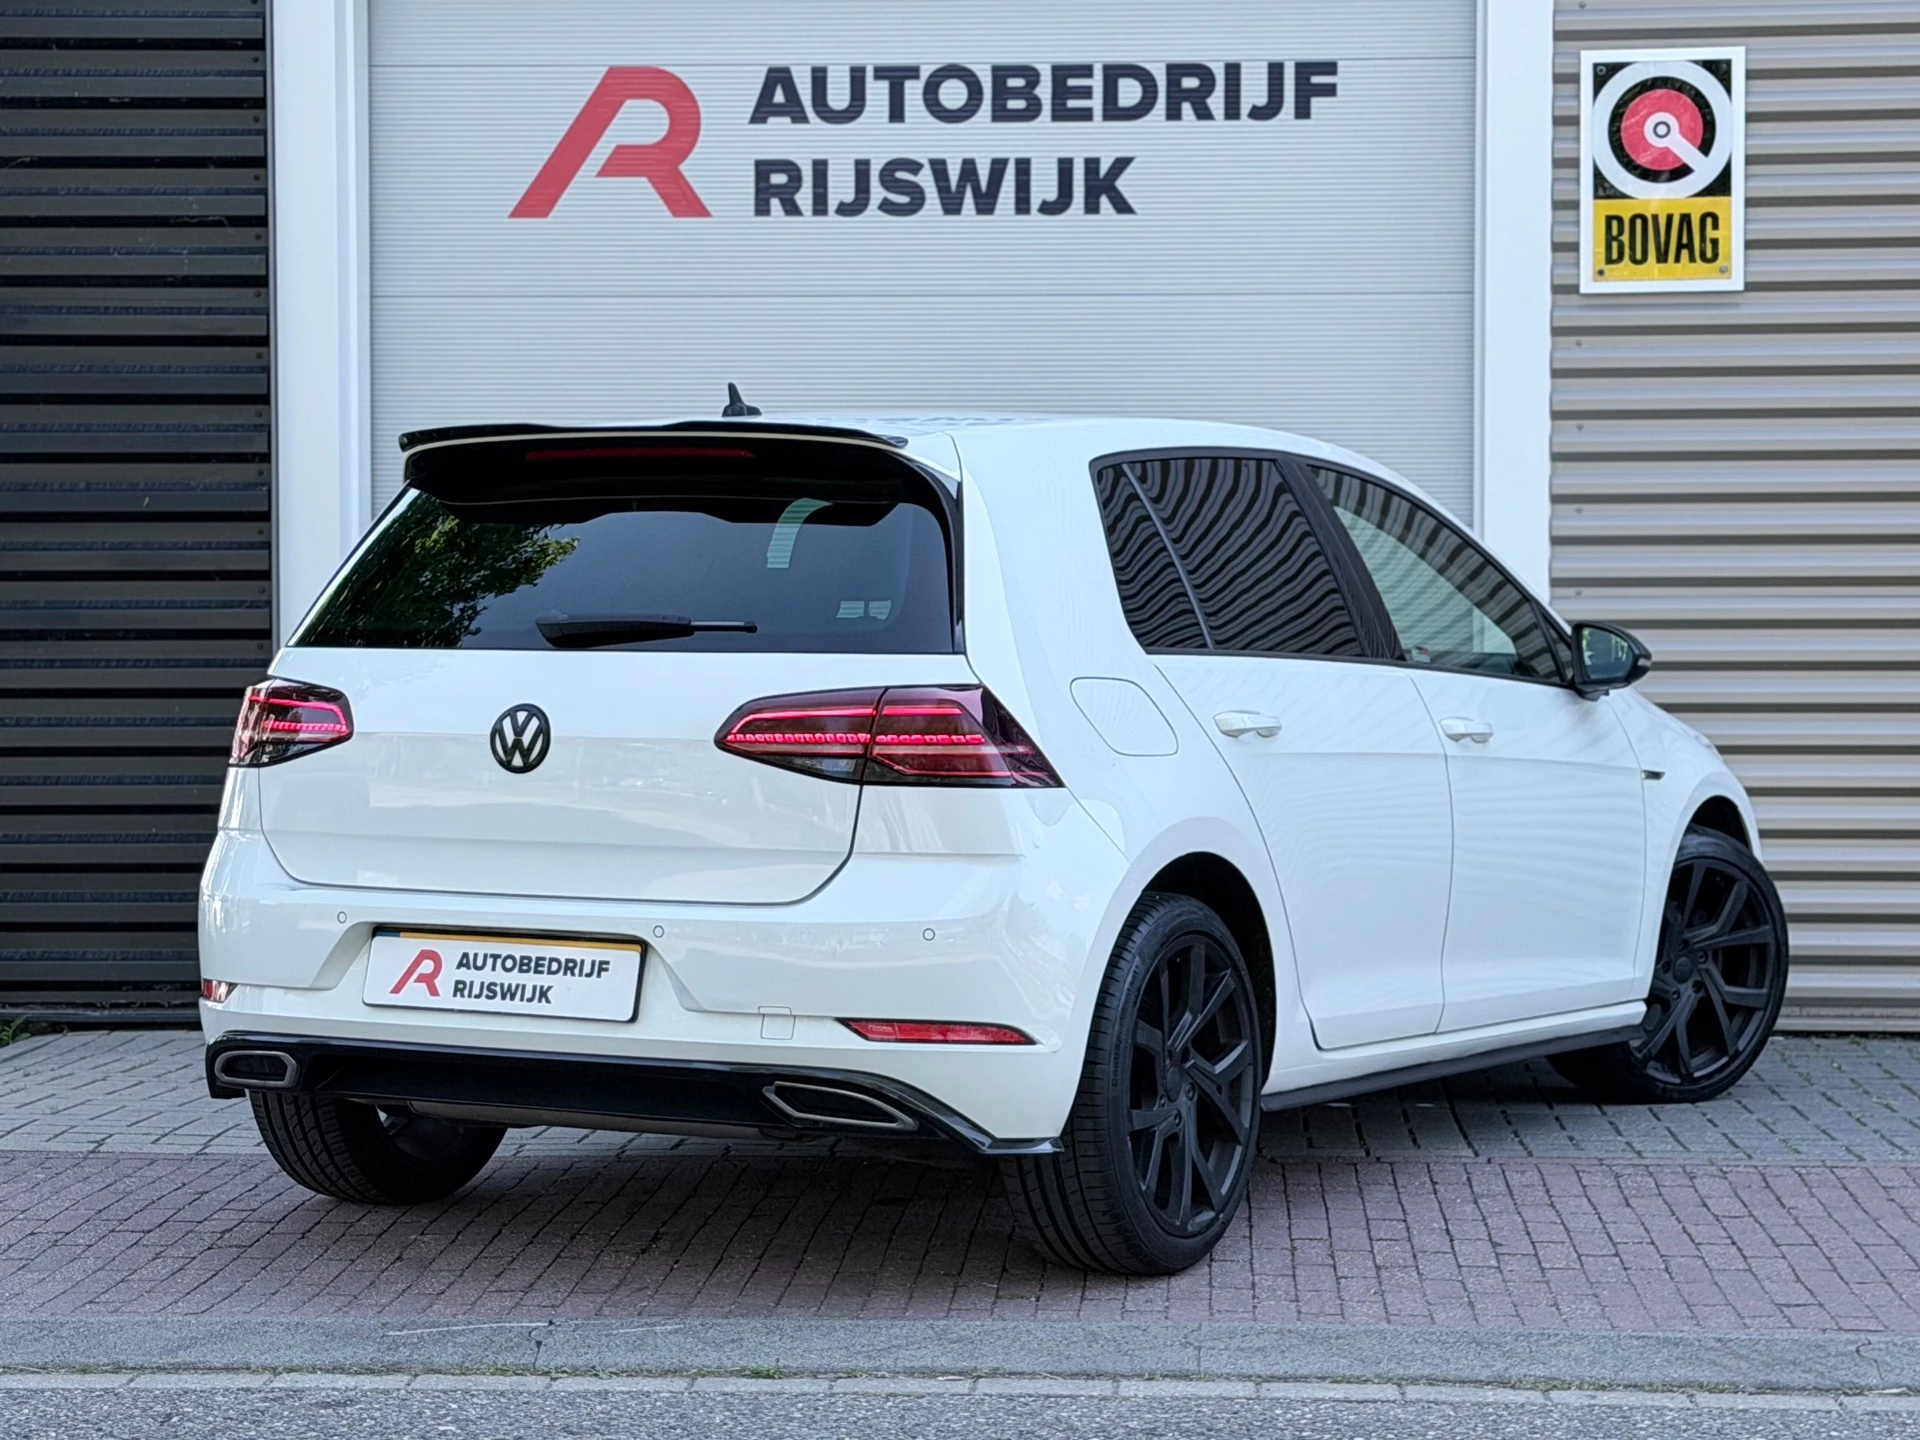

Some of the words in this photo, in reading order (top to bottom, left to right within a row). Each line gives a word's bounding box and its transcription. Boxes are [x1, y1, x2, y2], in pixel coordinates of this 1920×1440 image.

[748, 61, 1338, 124] AUTOBEDRIJF
[754, 157, 1137, 216] RIJSWIJK
[1604, 211, 1719, 266] BOVAG
[492, 704, 549, 772] VW
[452, 980, 553, 1004] RIJSWIJK
[455, 951, 611, 979] AUTOBEDRIJF
